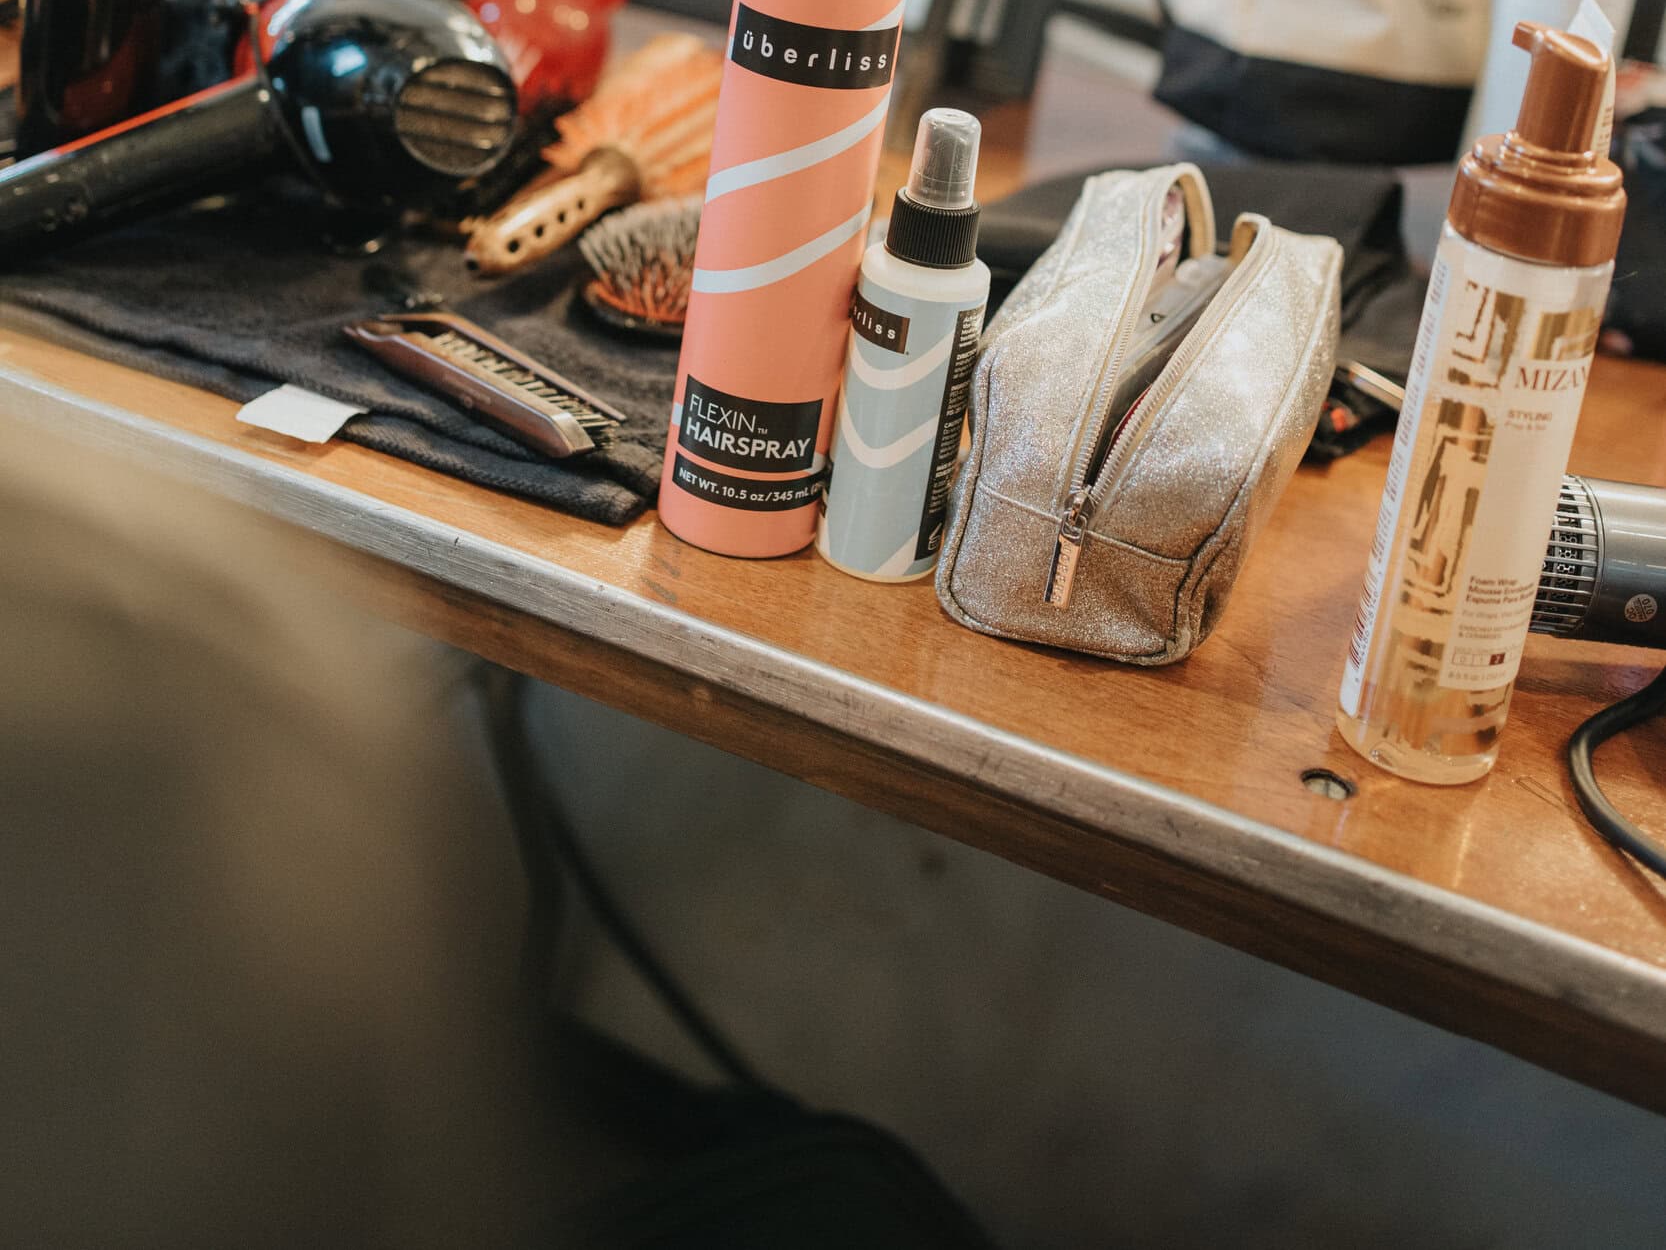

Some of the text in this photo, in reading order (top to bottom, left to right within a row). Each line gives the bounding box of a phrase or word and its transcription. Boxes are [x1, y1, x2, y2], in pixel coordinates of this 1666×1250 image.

[743, 29, 887, 71] überliss
[688, 393, 757, 433] FLEXIN
[685, 416, 811, 459] HAIRSPRAY
[678, 467, 698, 485] NET
[698, 476, 720, 494] WT.
[722, 486, 747, 500] 10.5
